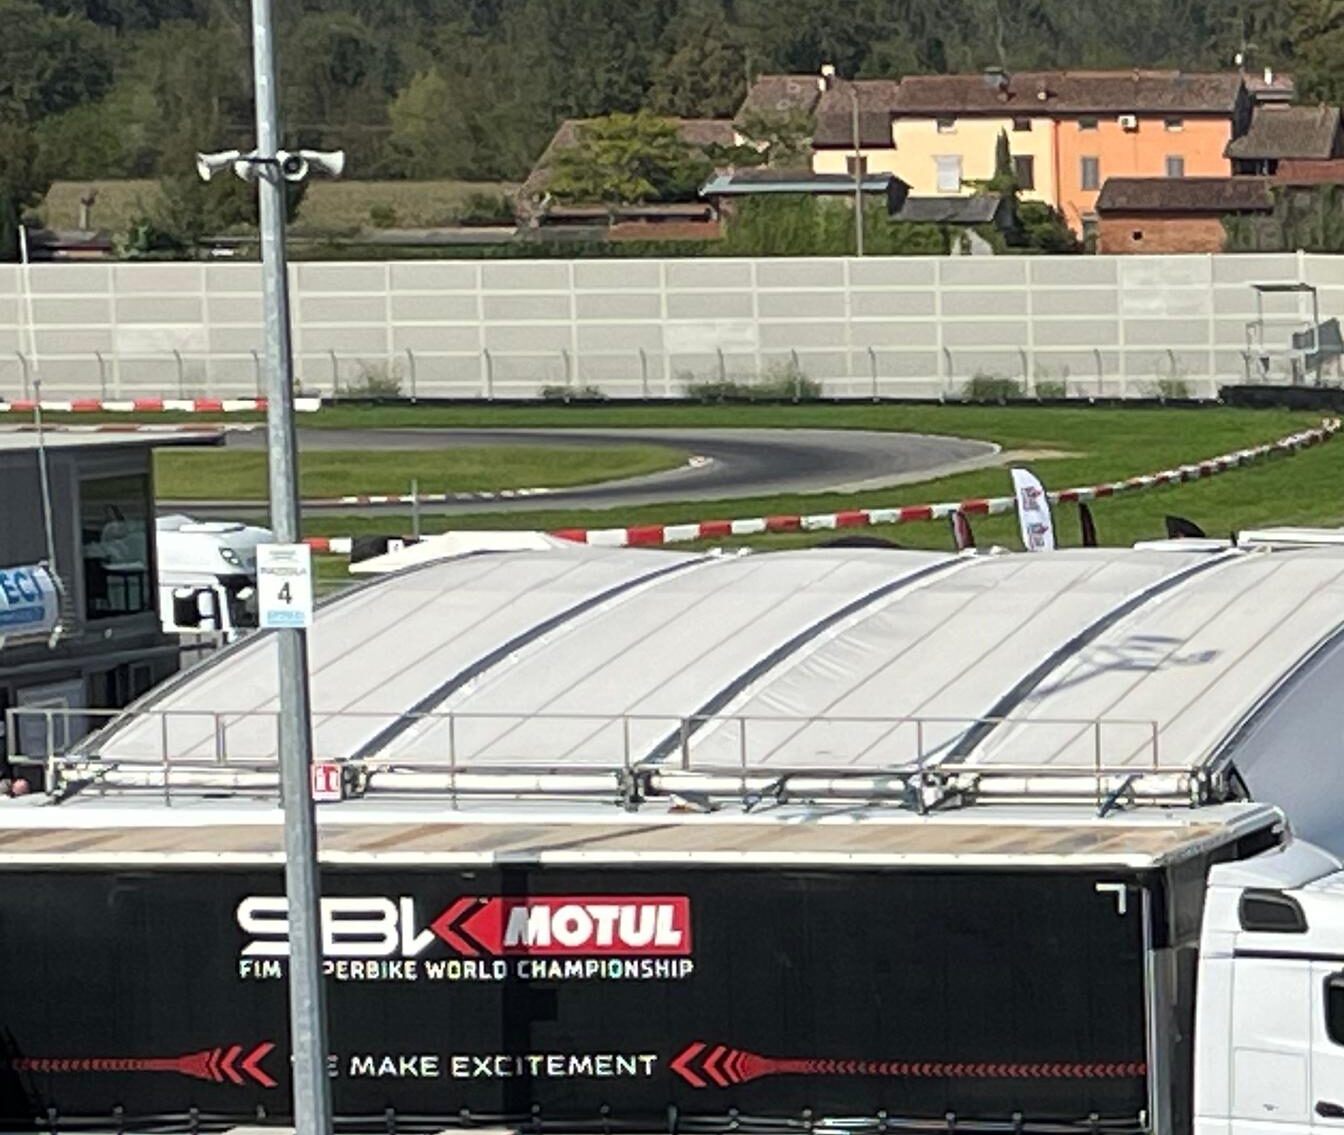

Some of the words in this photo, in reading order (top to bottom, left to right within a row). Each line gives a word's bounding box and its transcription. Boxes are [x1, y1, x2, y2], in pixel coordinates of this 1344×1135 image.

[277, 581, 292, 605] 4
[237, 896, 480, 957] SBK
[504, 904, 683, 947] MOTUL
[239, 960, 282, 980] FIM
[321, 960, 419, 981] PERBIKE
[425, 960, 507, 980] WORLD
[517, 959, 694, 980] CHAMPIONSHIP
[350, 1055, 440, 1078] MAKE
[451, 1054, 658, 1078] EXCITEMENT
